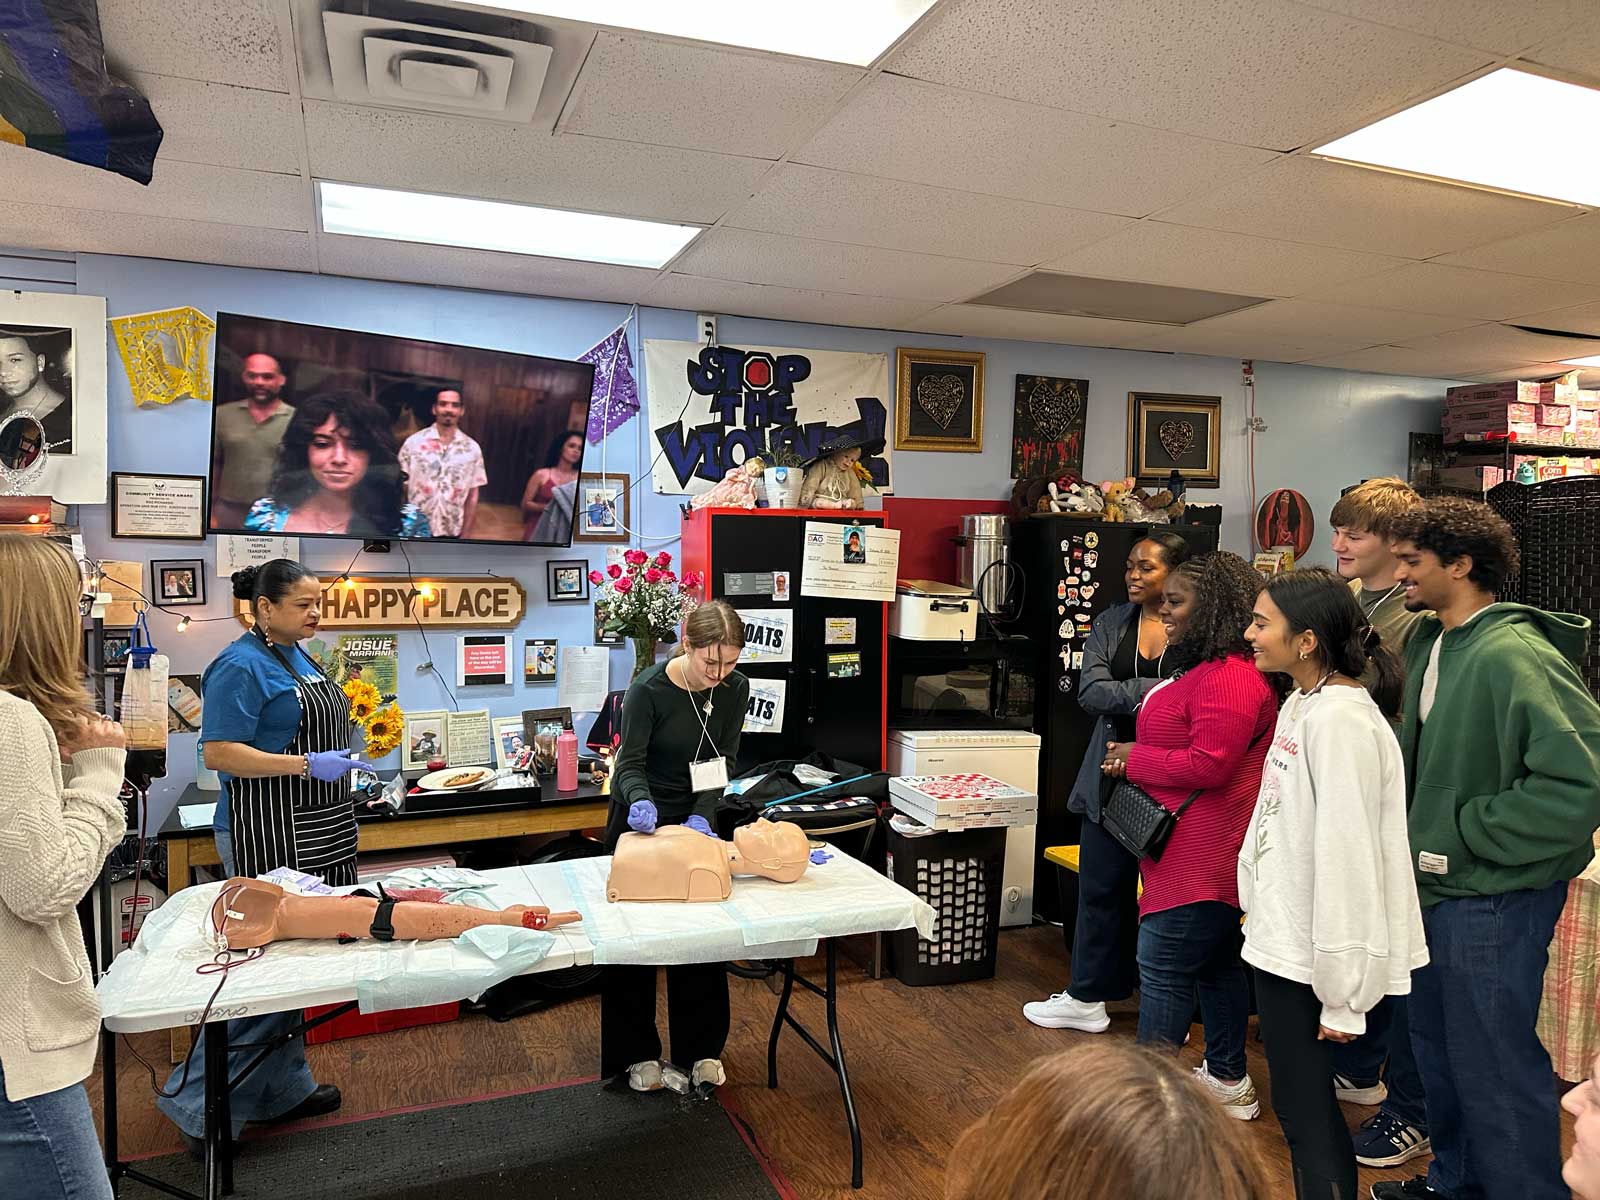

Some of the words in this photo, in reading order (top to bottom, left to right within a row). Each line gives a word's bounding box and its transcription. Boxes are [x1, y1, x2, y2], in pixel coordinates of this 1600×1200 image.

[687, 346, 812, 395] STOP
[709, 391, 798, 430] THE
[321, 588, 415, 619] HAPPY
[422, 588, 509, 618] PLACE
[343, 640, 393, 651] JOSUE
[744, 623, 783, 648] OATS
